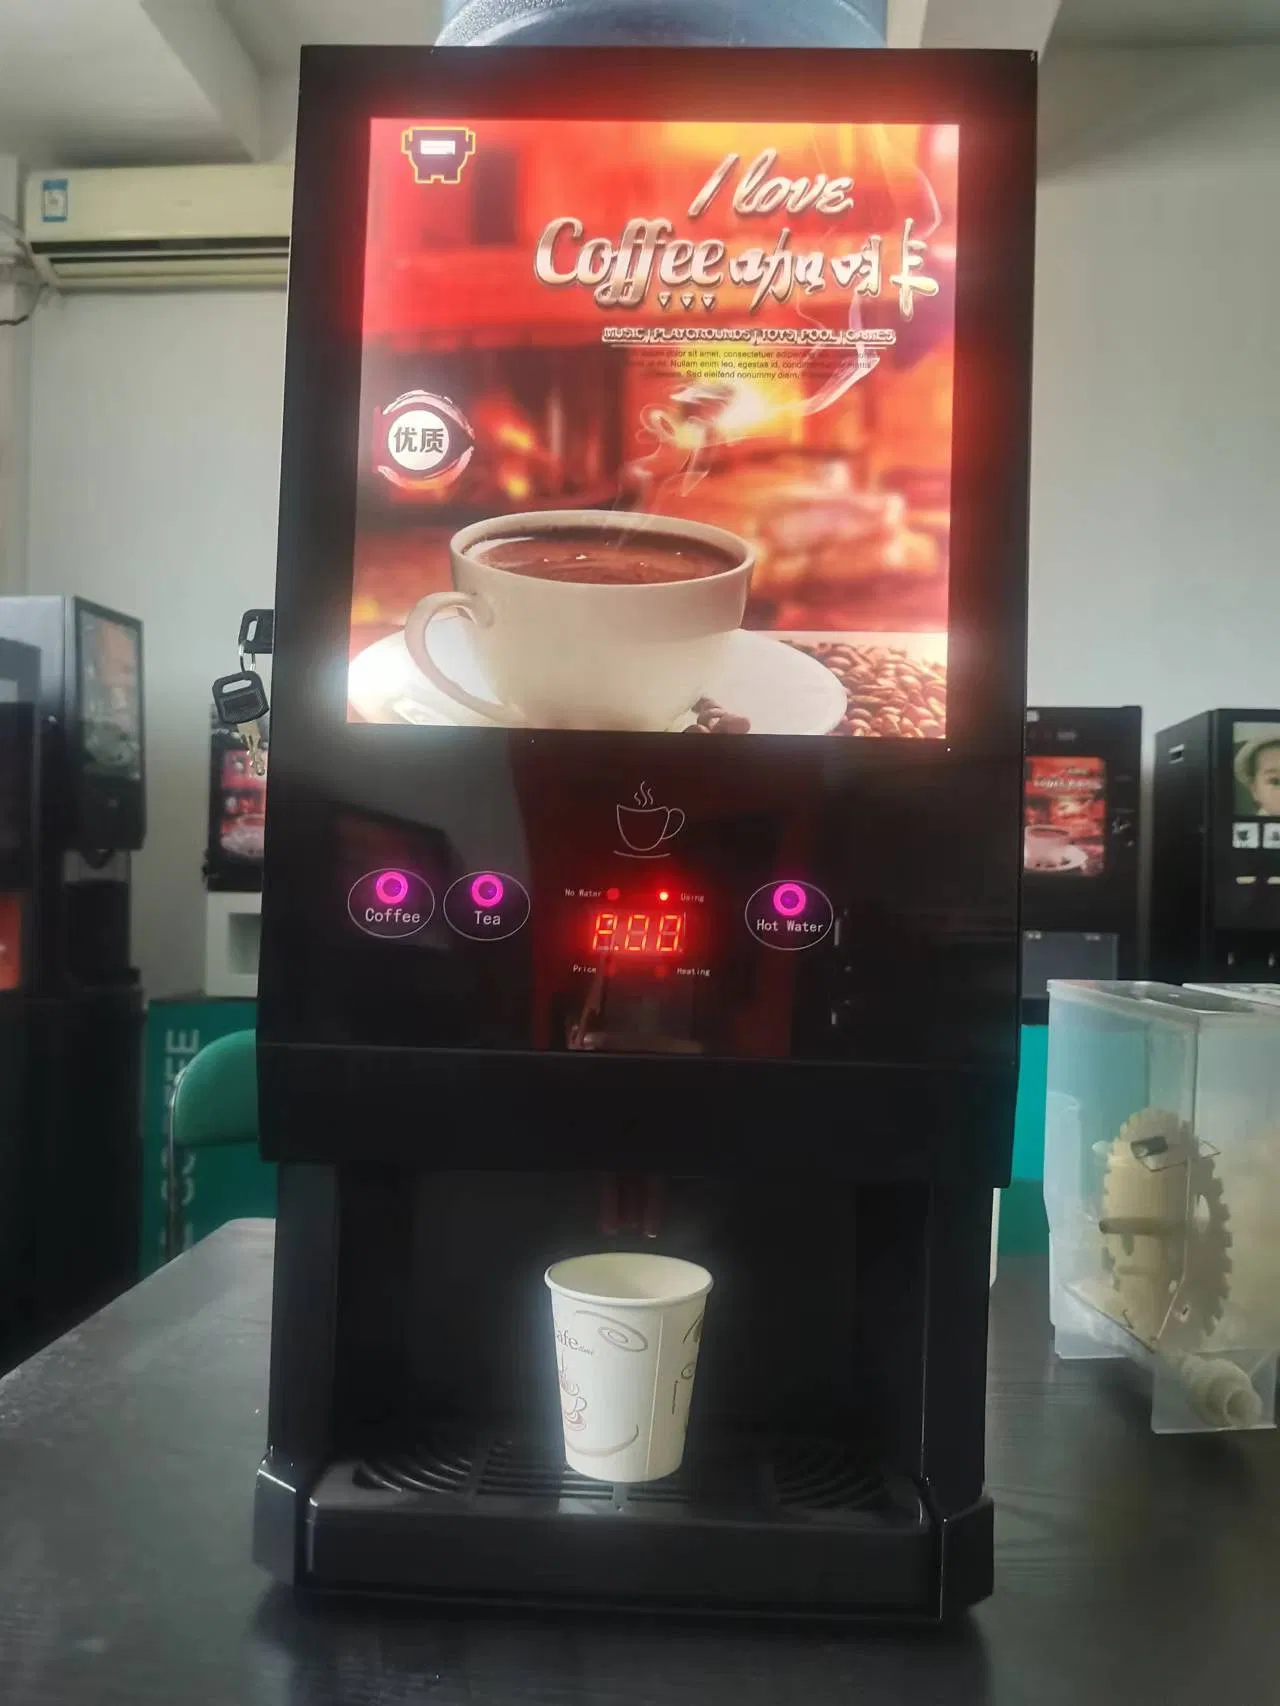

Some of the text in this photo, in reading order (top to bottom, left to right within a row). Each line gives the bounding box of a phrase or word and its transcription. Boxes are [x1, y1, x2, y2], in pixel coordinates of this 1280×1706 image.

[688, 148, 854, 216] I love
[535, 217, 725, 306] Coffee
[602, 327, 646, 342] MUSIC
[653, 327, 750, 342] PLAYGROUNDS
[846, 329, 896, 345] GAMES
[394, 427, 445, 454] 优质
[564, 888, 602, 898] No Water
[365, 907, 421, 924] Coffee
[474, 910, 501, 926] Tea
[756, 919, 824, 933] Hot Water
[572, 964, 597, 974] Price
[676, 967, 711, 977] Heating
